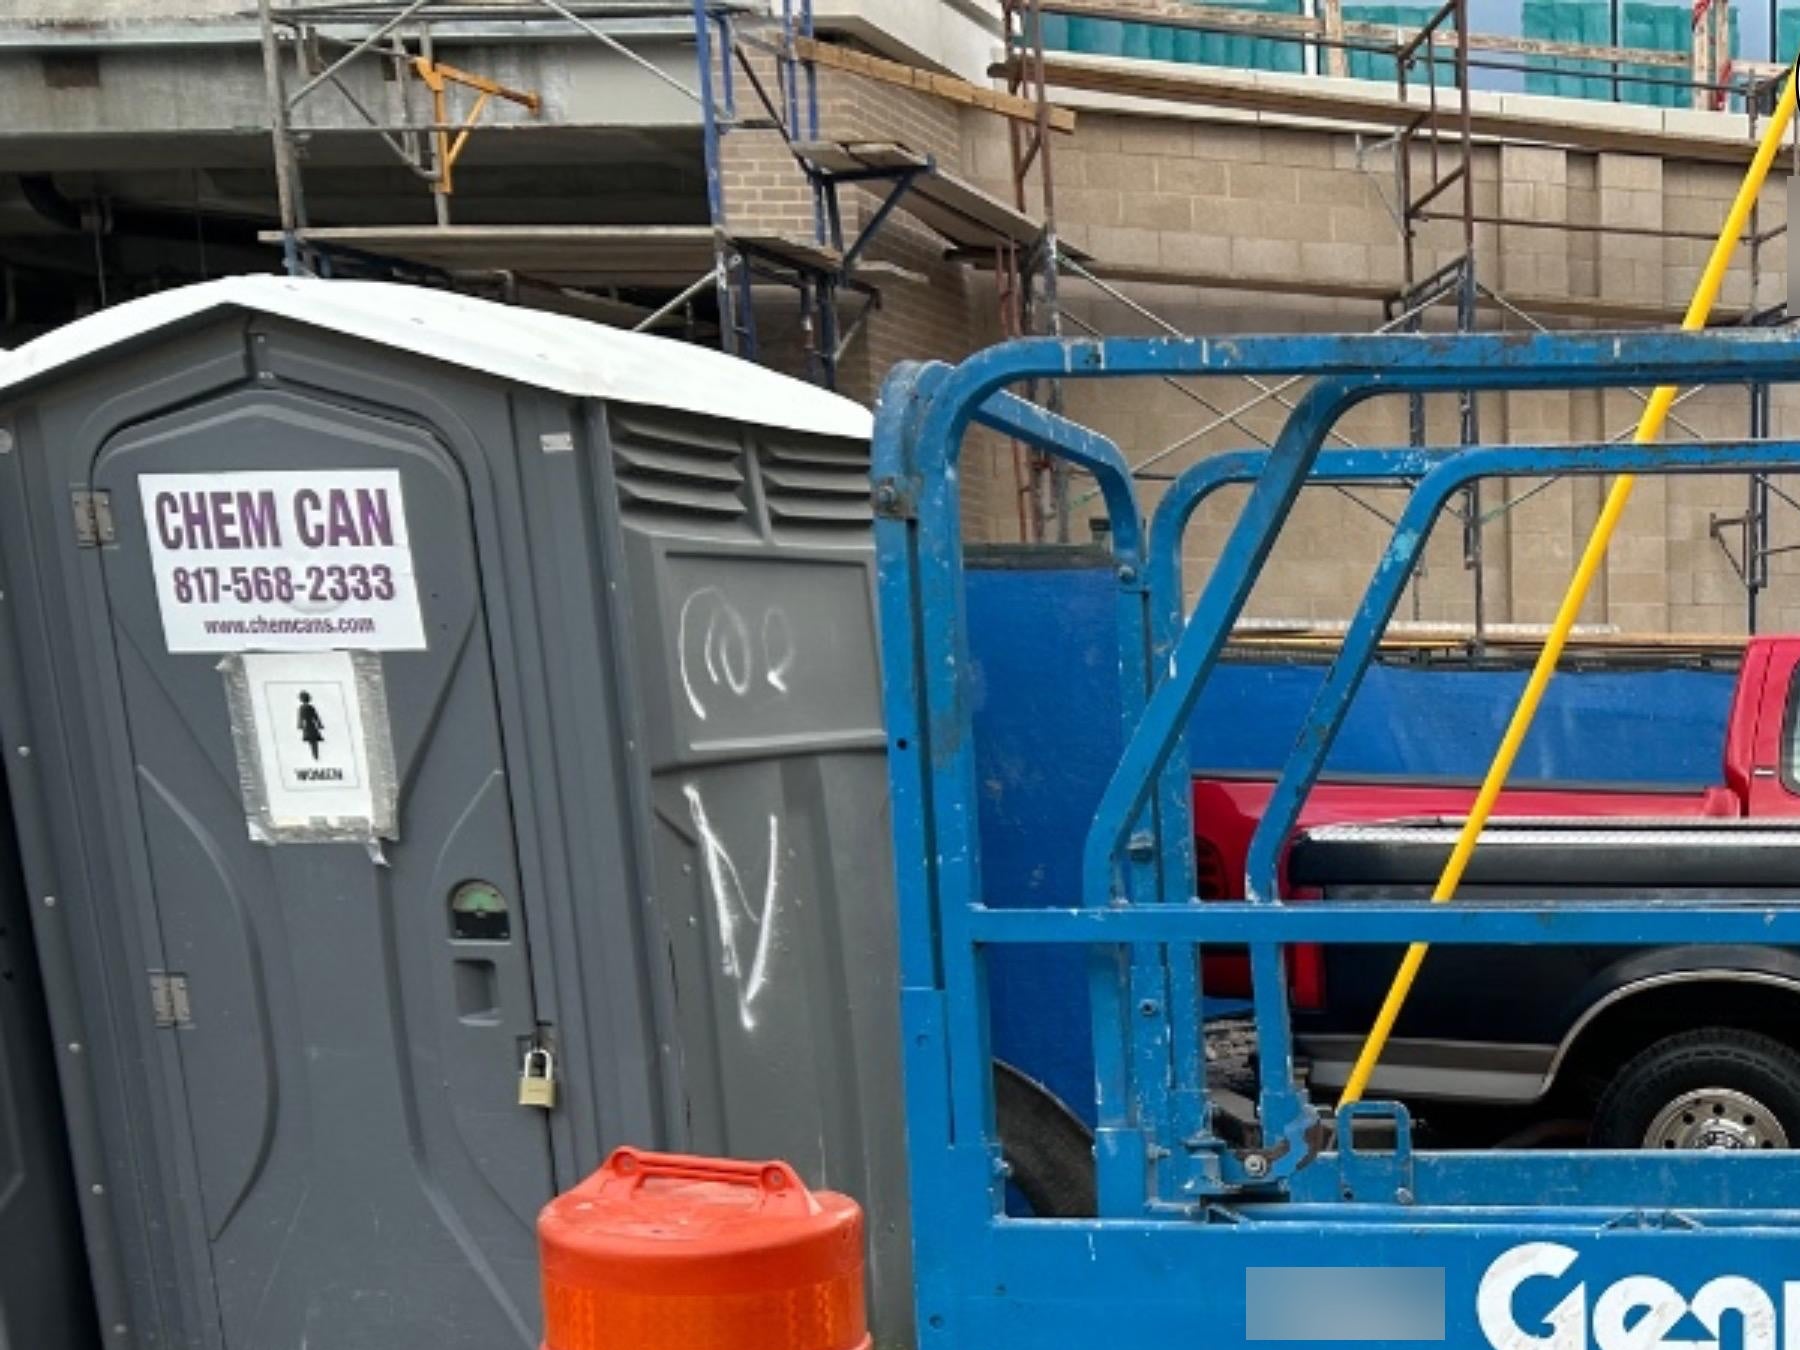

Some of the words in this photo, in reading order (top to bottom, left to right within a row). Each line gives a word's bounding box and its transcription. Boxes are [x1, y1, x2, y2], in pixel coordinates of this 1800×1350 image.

[155, 490, 282, 549] CHEM
[294, 488, 394, 548] CAN
[173, 562, 394, 604] 817-568-2333
[204, 614, 376, 634] www.chemcans.com
[295, 767, 343, 781] WOMEN
